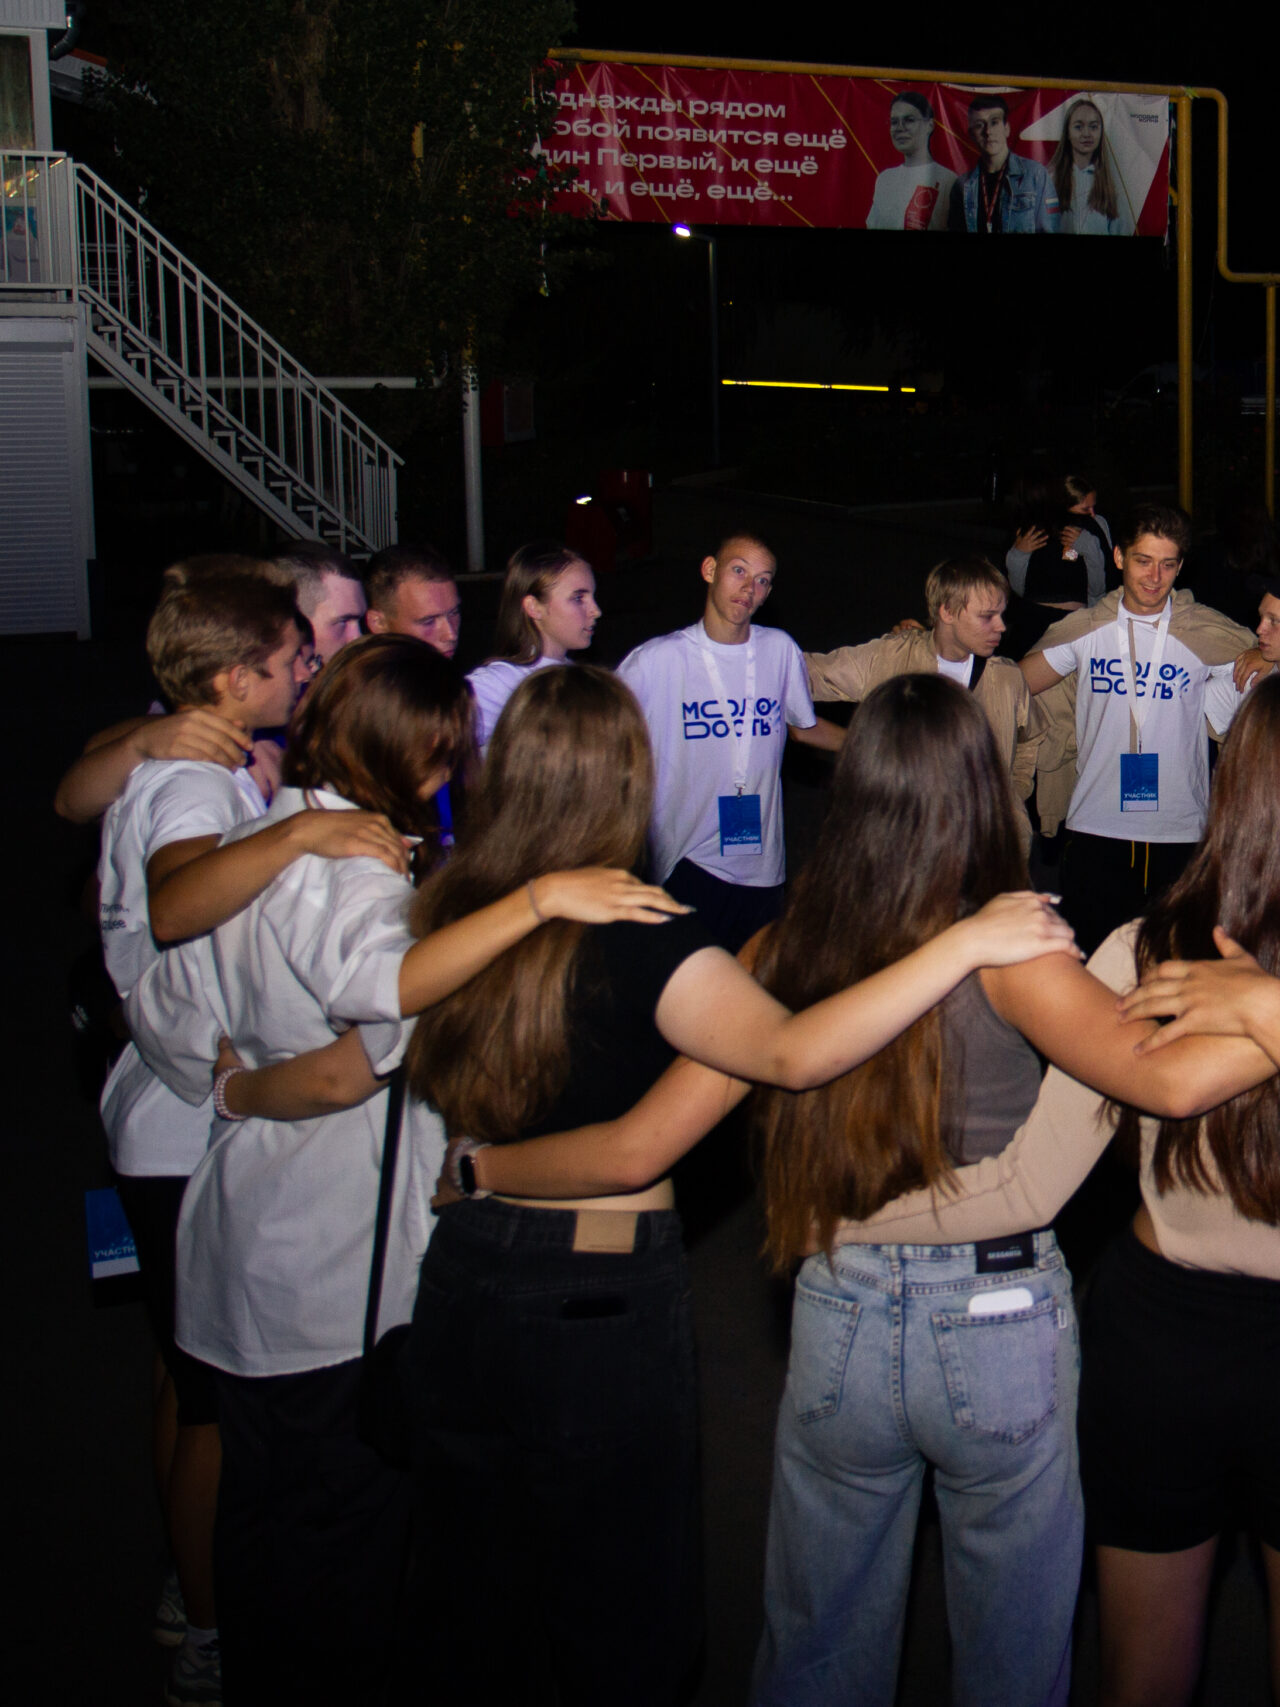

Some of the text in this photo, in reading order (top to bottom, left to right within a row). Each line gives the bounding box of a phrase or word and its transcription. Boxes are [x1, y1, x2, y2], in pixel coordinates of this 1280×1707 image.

[689, 100, 786, 119] рядом
[551, 118, 848, 151] обой появится ещё
[597, 148, 725, 173] Первый,
[731, 158, 749, 172] и
[754, 155, 819, 178] ещё
[605, 180, 625, 195] и
[630, 178, 700, 201] ещё,
[706, 181, 793, 204] ещё...
[94, 1245, 136, 1259] УЧАСТН
